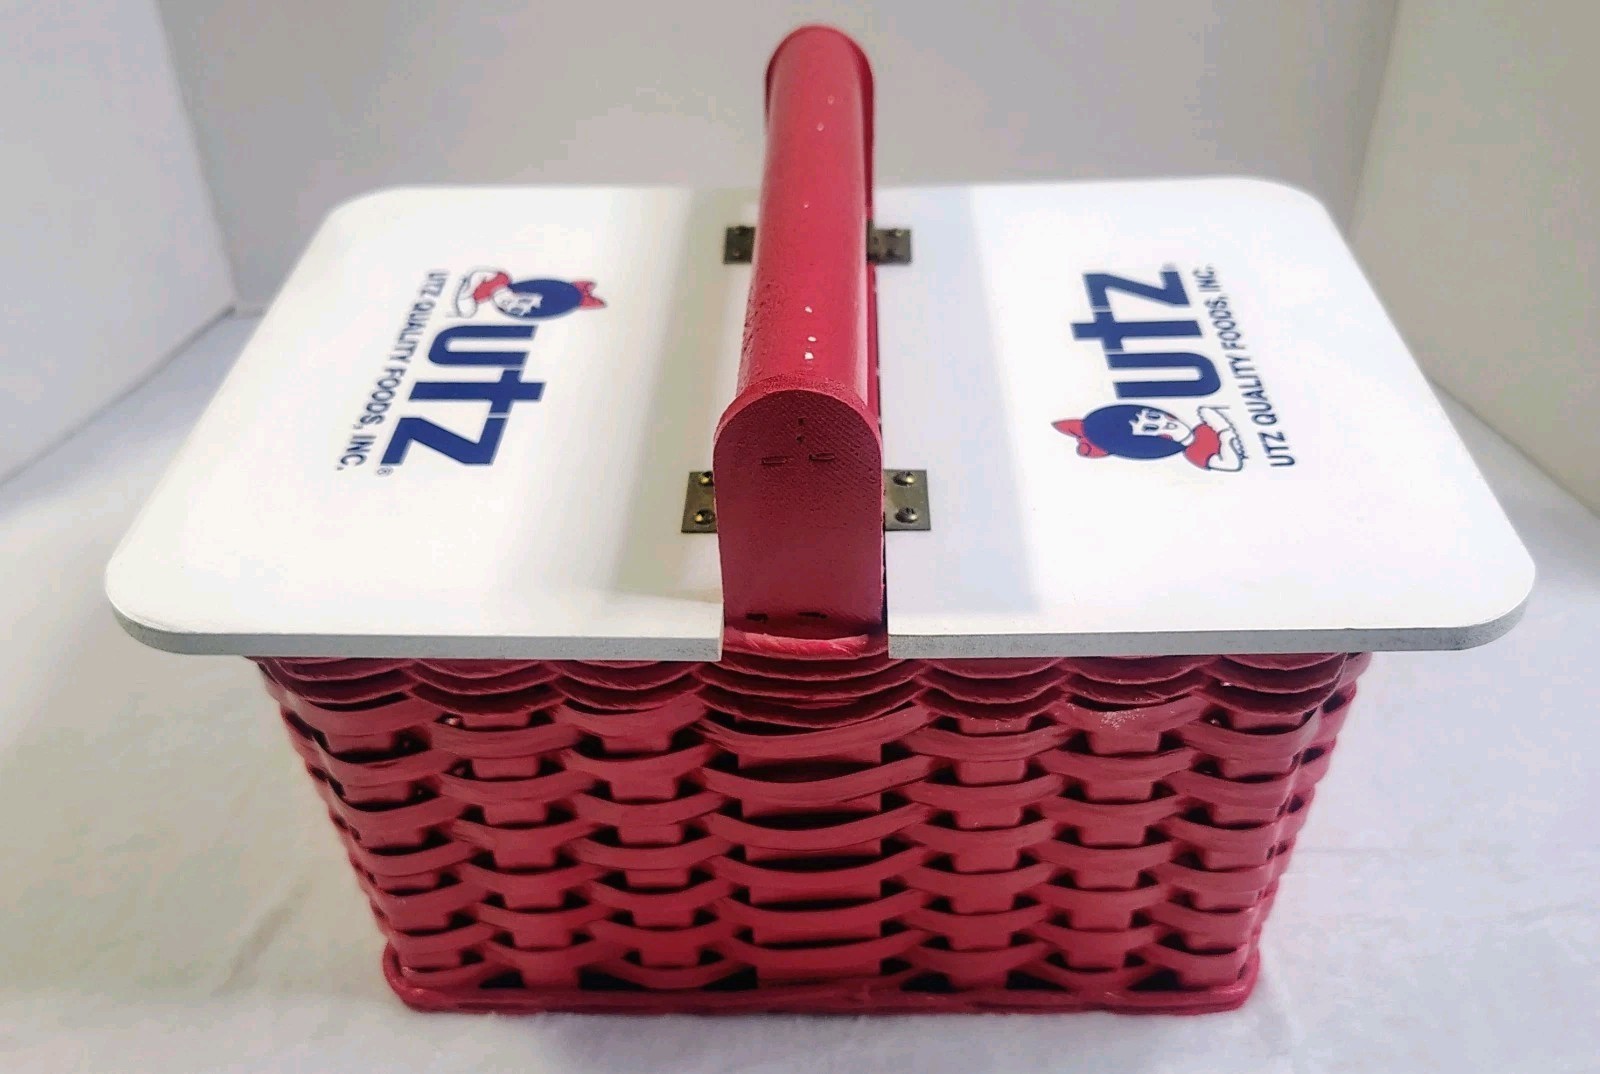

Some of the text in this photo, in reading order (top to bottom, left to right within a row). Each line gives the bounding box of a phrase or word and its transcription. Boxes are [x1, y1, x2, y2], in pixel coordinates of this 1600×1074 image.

[421, 269, 449, 298] UTZ
[390, 300, 436, 364] QUALITY
[1225, 354, 1278, 426] QUALITY
[336, 434, 377, 471] INC.
[1257, 431, 1296, 467] UTZ
